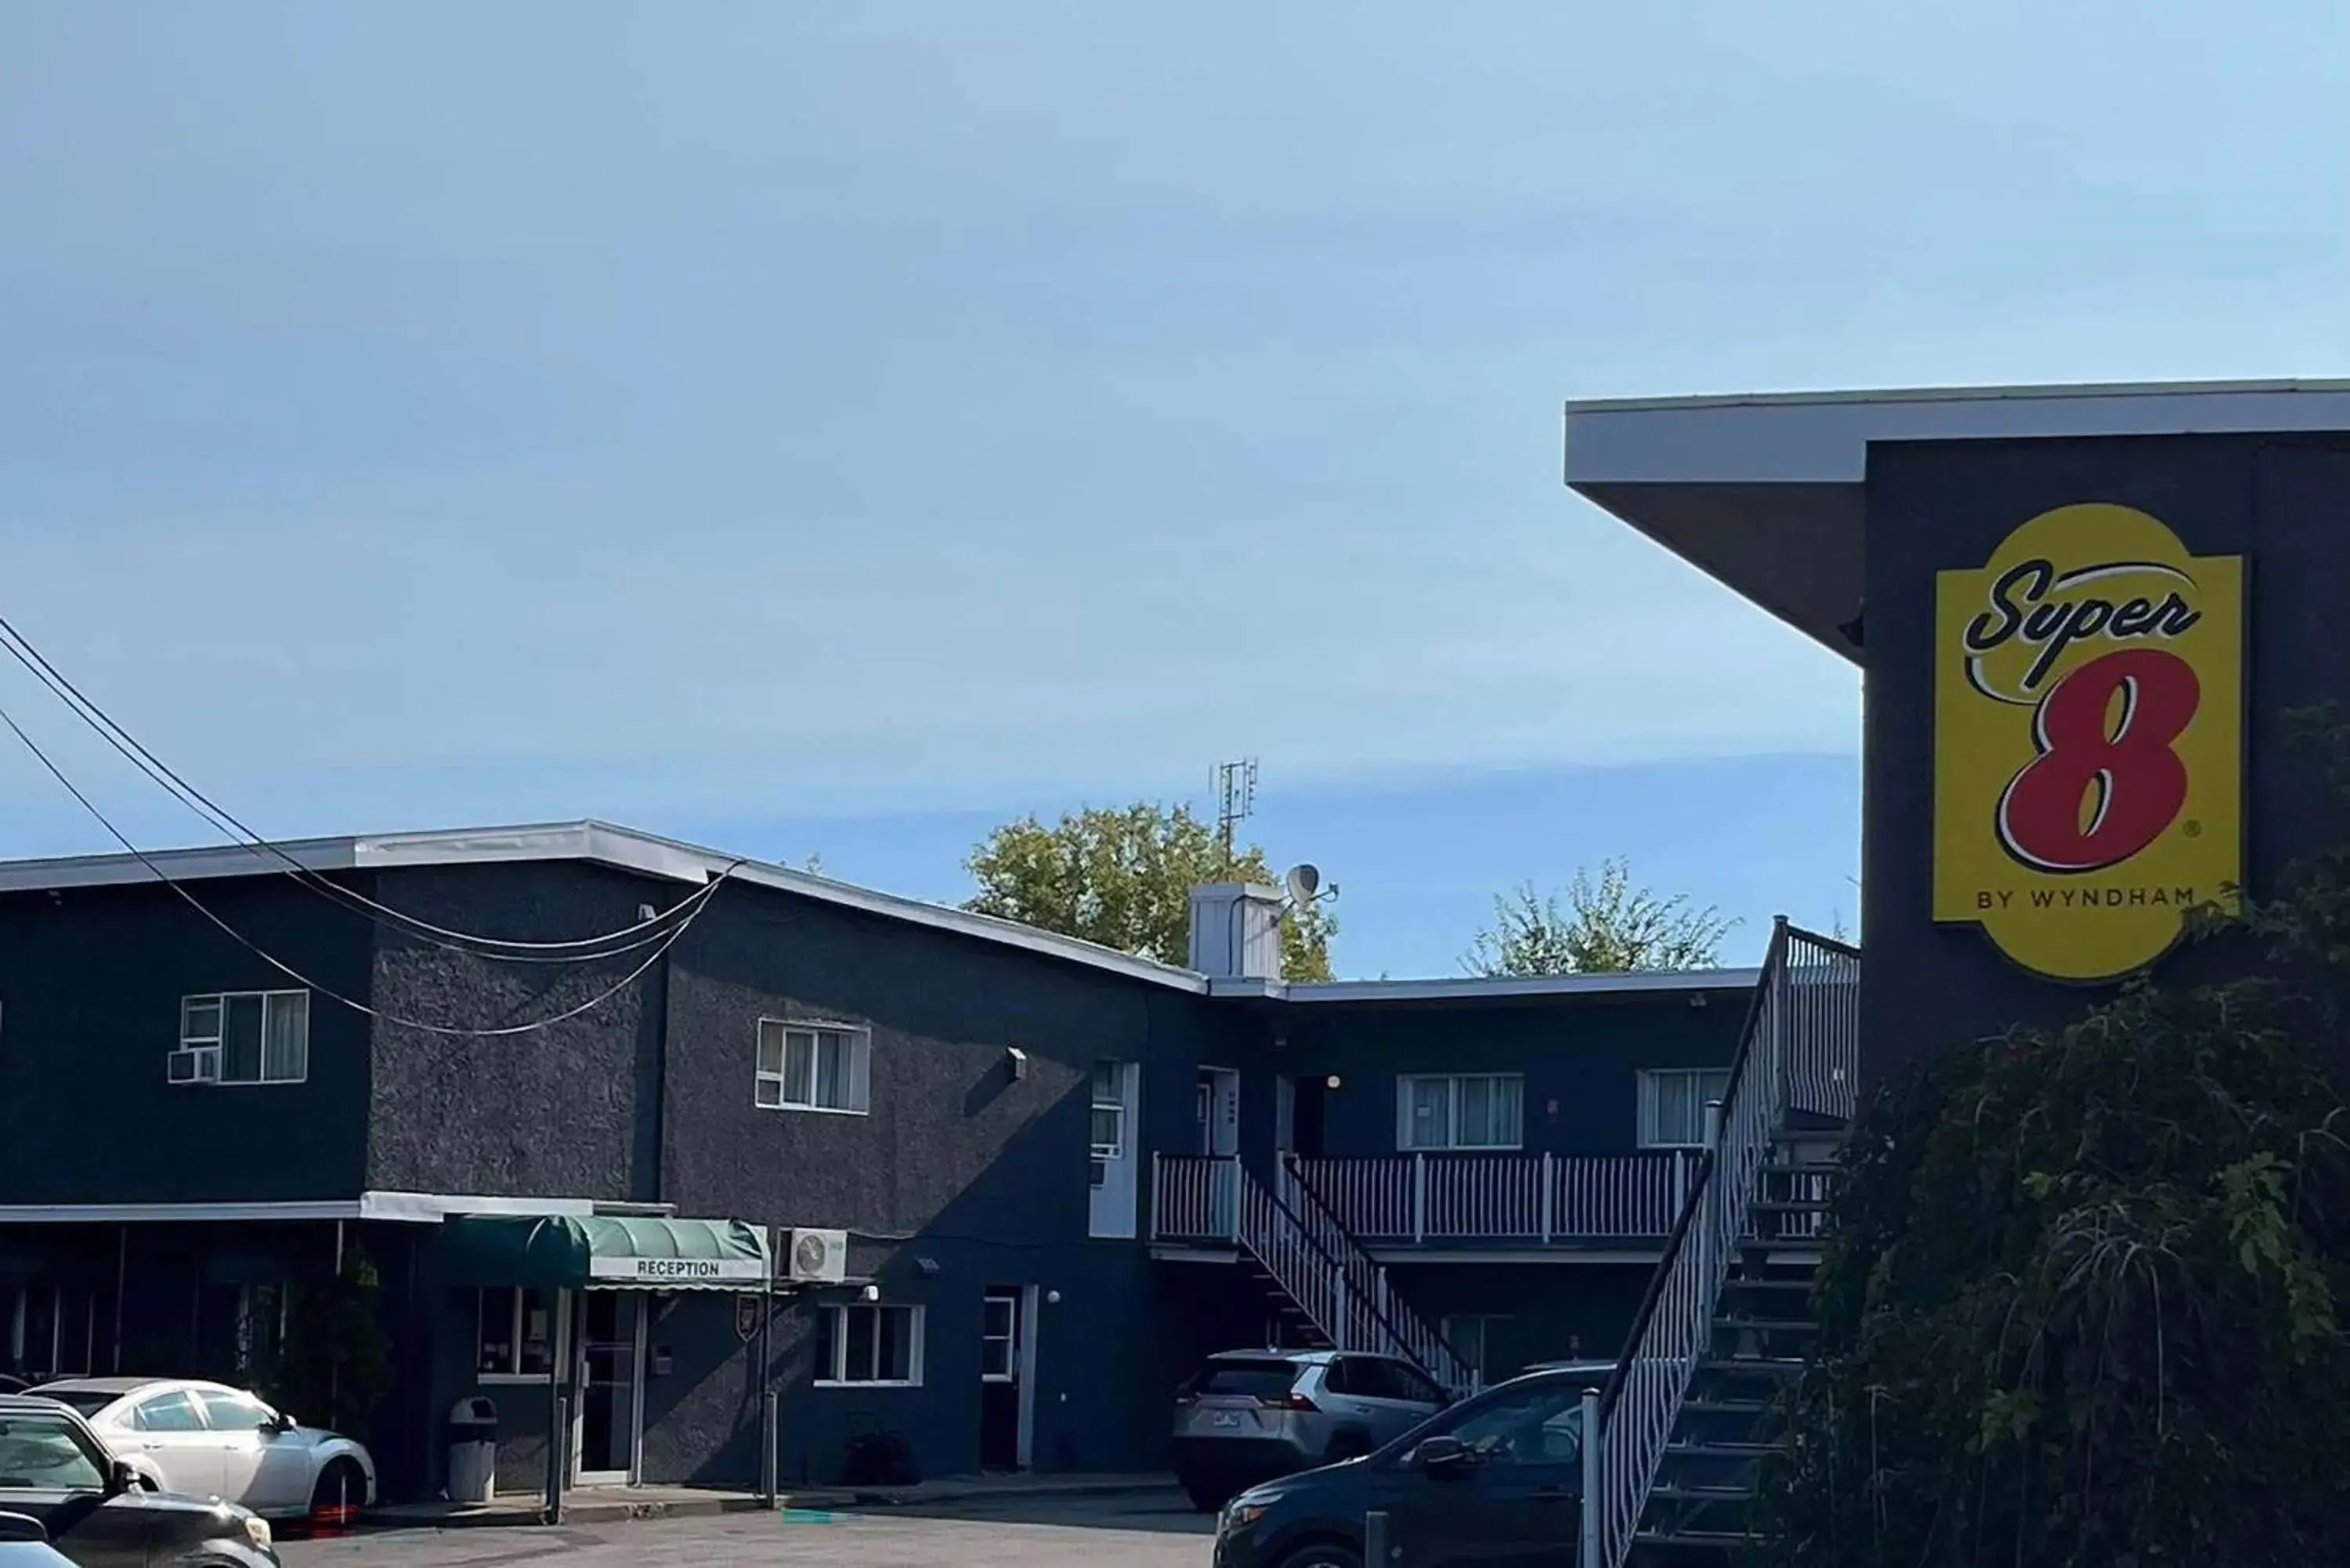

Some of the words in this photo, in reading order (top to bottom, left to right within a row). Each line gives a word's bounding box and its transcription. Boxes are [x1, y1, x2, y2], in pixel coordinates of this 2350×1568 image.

[1964, 559, 2202, 691] Super
[1994, 649, 2200, 874] 8
[1977, 891, 2014, 909] BY
[2030, 887, 2194, 908] WYNDHAM
[638, 1259, 720, 1276] RECEPTION
